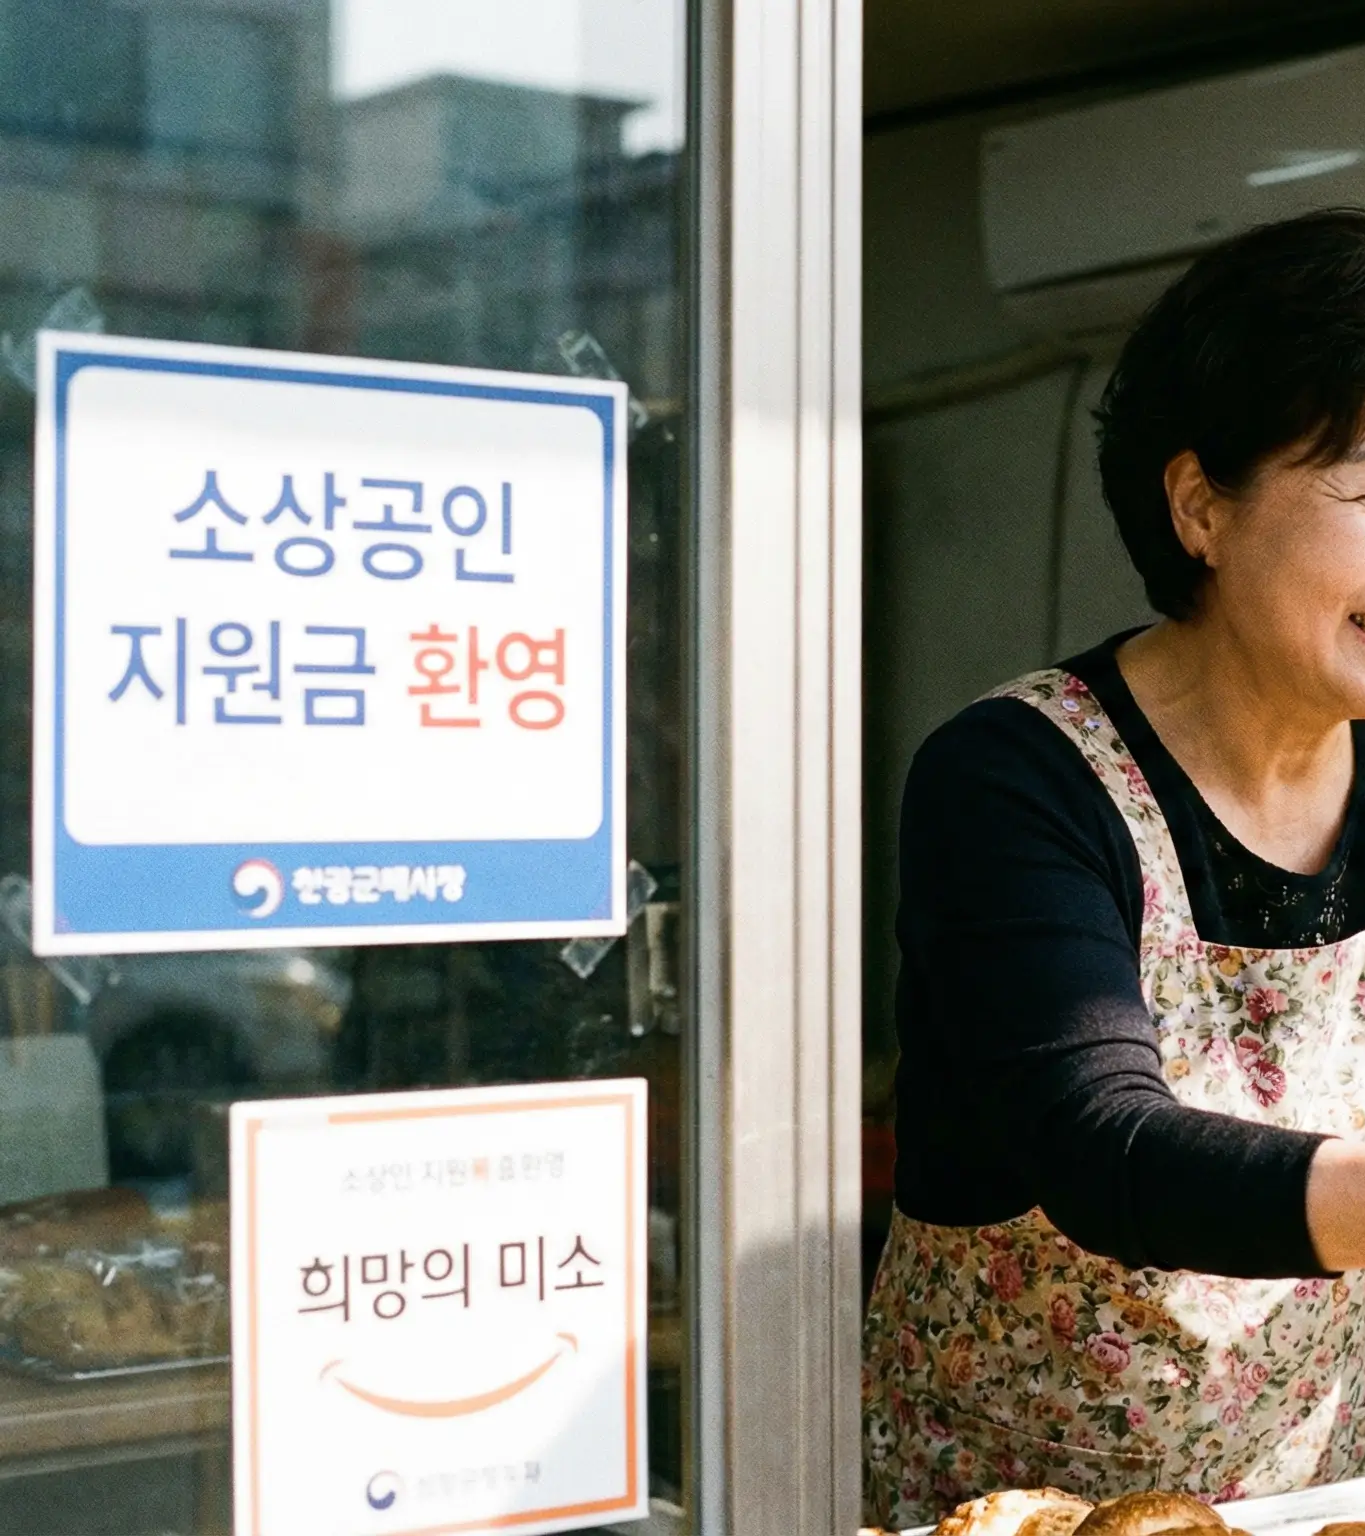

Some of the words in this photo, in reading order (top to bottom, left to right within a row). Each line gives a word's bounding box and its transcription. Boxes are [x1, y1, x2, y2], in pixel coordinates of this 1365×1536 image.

[169, 470, 515, 584] 소상공인
[108, 617, 377, 727] 지원금
[407, 623, 566, 731] 환영
[298, 1243, 470, 1322] 희망의
[499, 1235, 604, 1301] 미소
